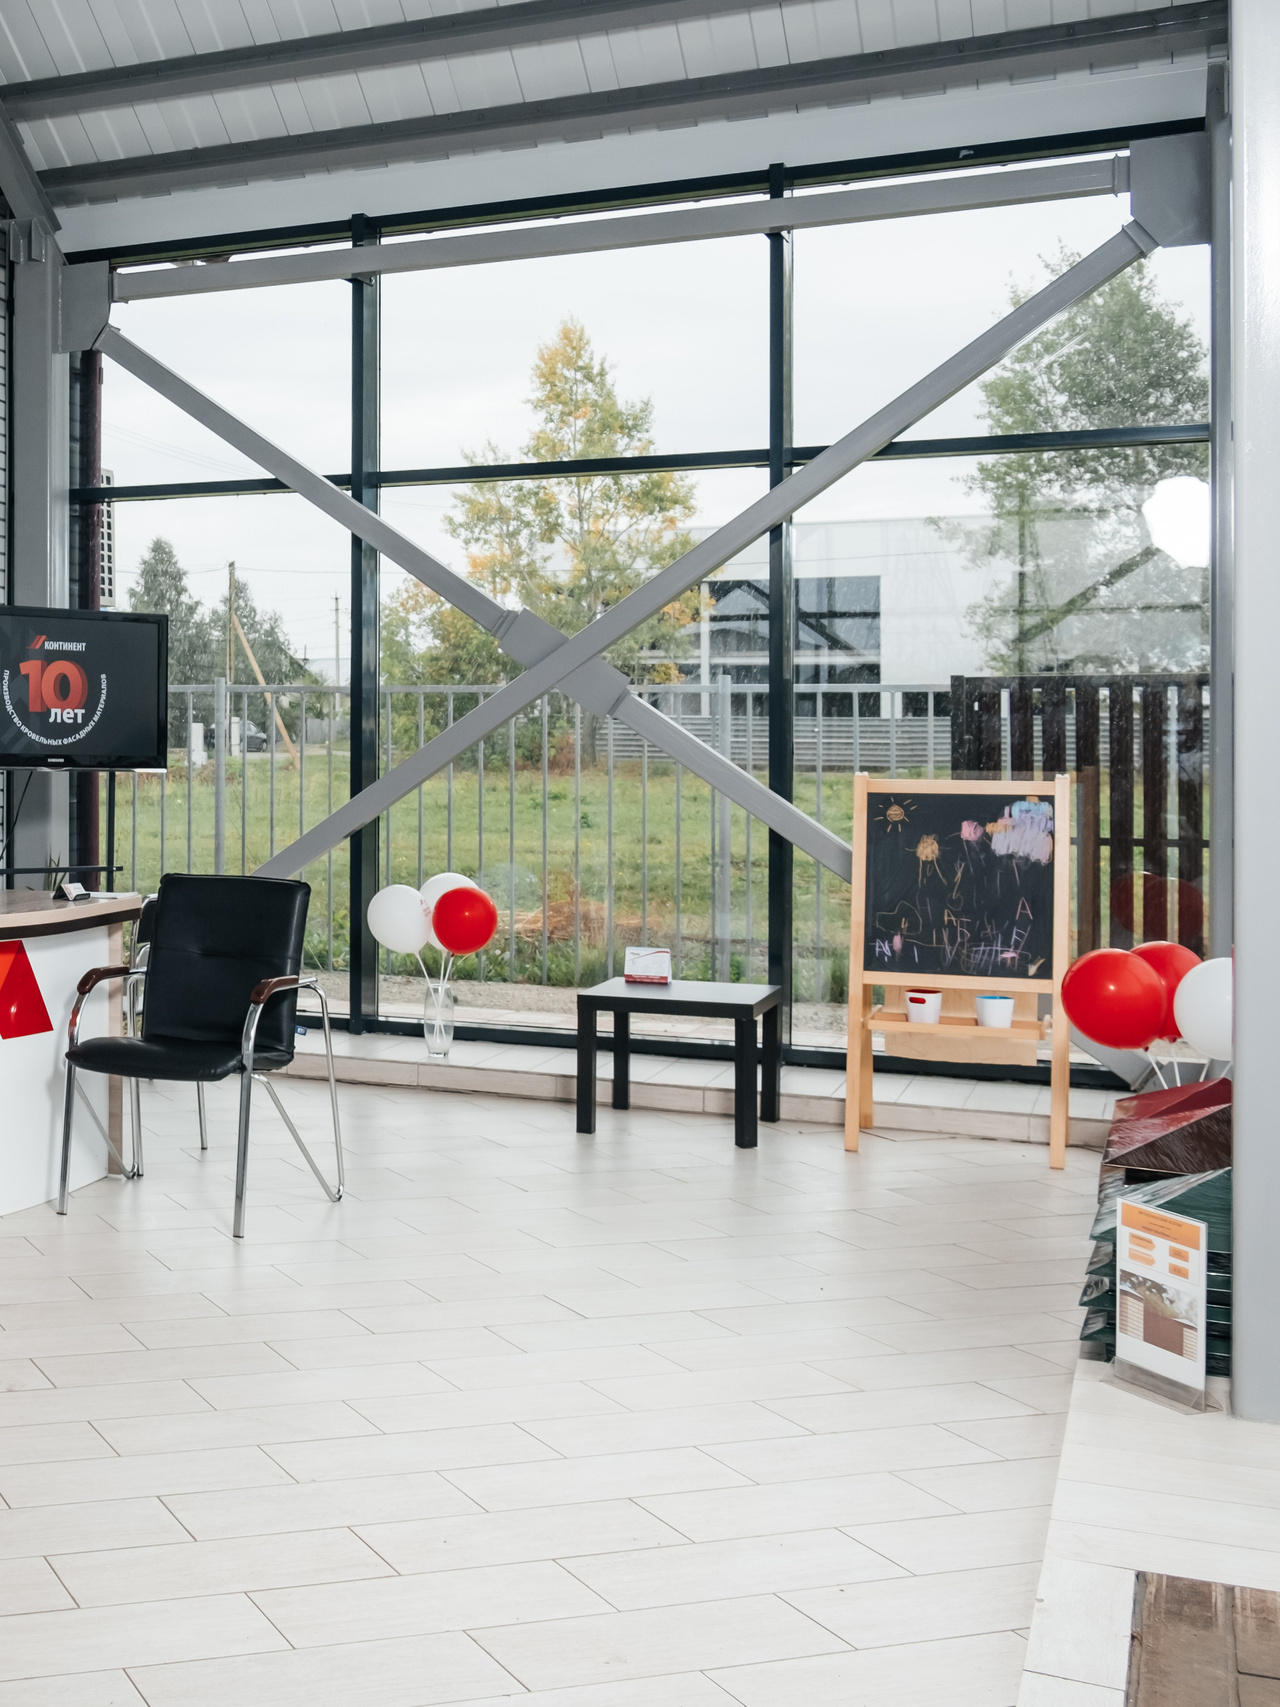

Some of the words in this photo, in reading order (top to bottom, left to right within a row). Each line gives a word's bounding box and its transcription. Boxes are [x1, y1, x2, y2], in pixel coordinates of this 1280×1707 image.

[44, 640, 87, 651] КОНТИНЕНТ
[2, 669, 22, 728] ПРОИЗВОДСТВО
[20, 724, 63, 746] КРОВЕЛЬНЫХ
[62, 720, 96, 745] ФАСАДНЫХ
[92, 673, 107, 723] МАТЕРИАЛОВ
[19, 659, 89, 713] 10
